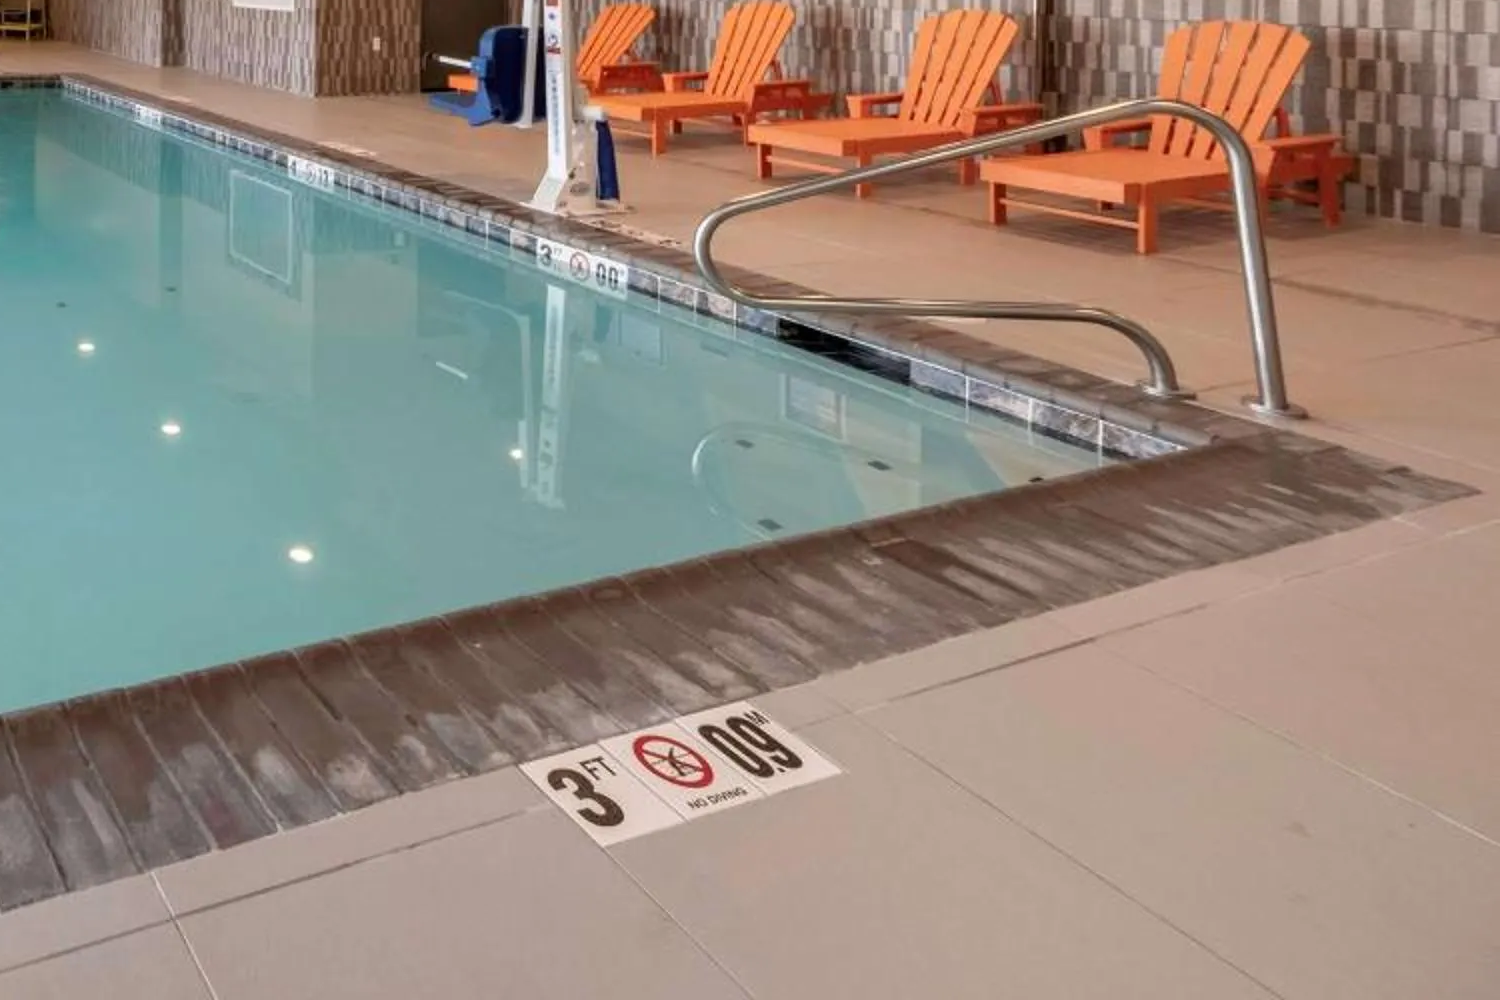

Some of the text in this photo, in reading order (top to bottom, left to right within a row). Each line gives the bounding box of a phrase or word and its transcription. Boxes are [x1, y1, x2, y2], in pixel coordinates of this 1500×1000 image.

[547, 756, 624, 827] 3 FT
[687, 787, 748, 810] NO DIVING
